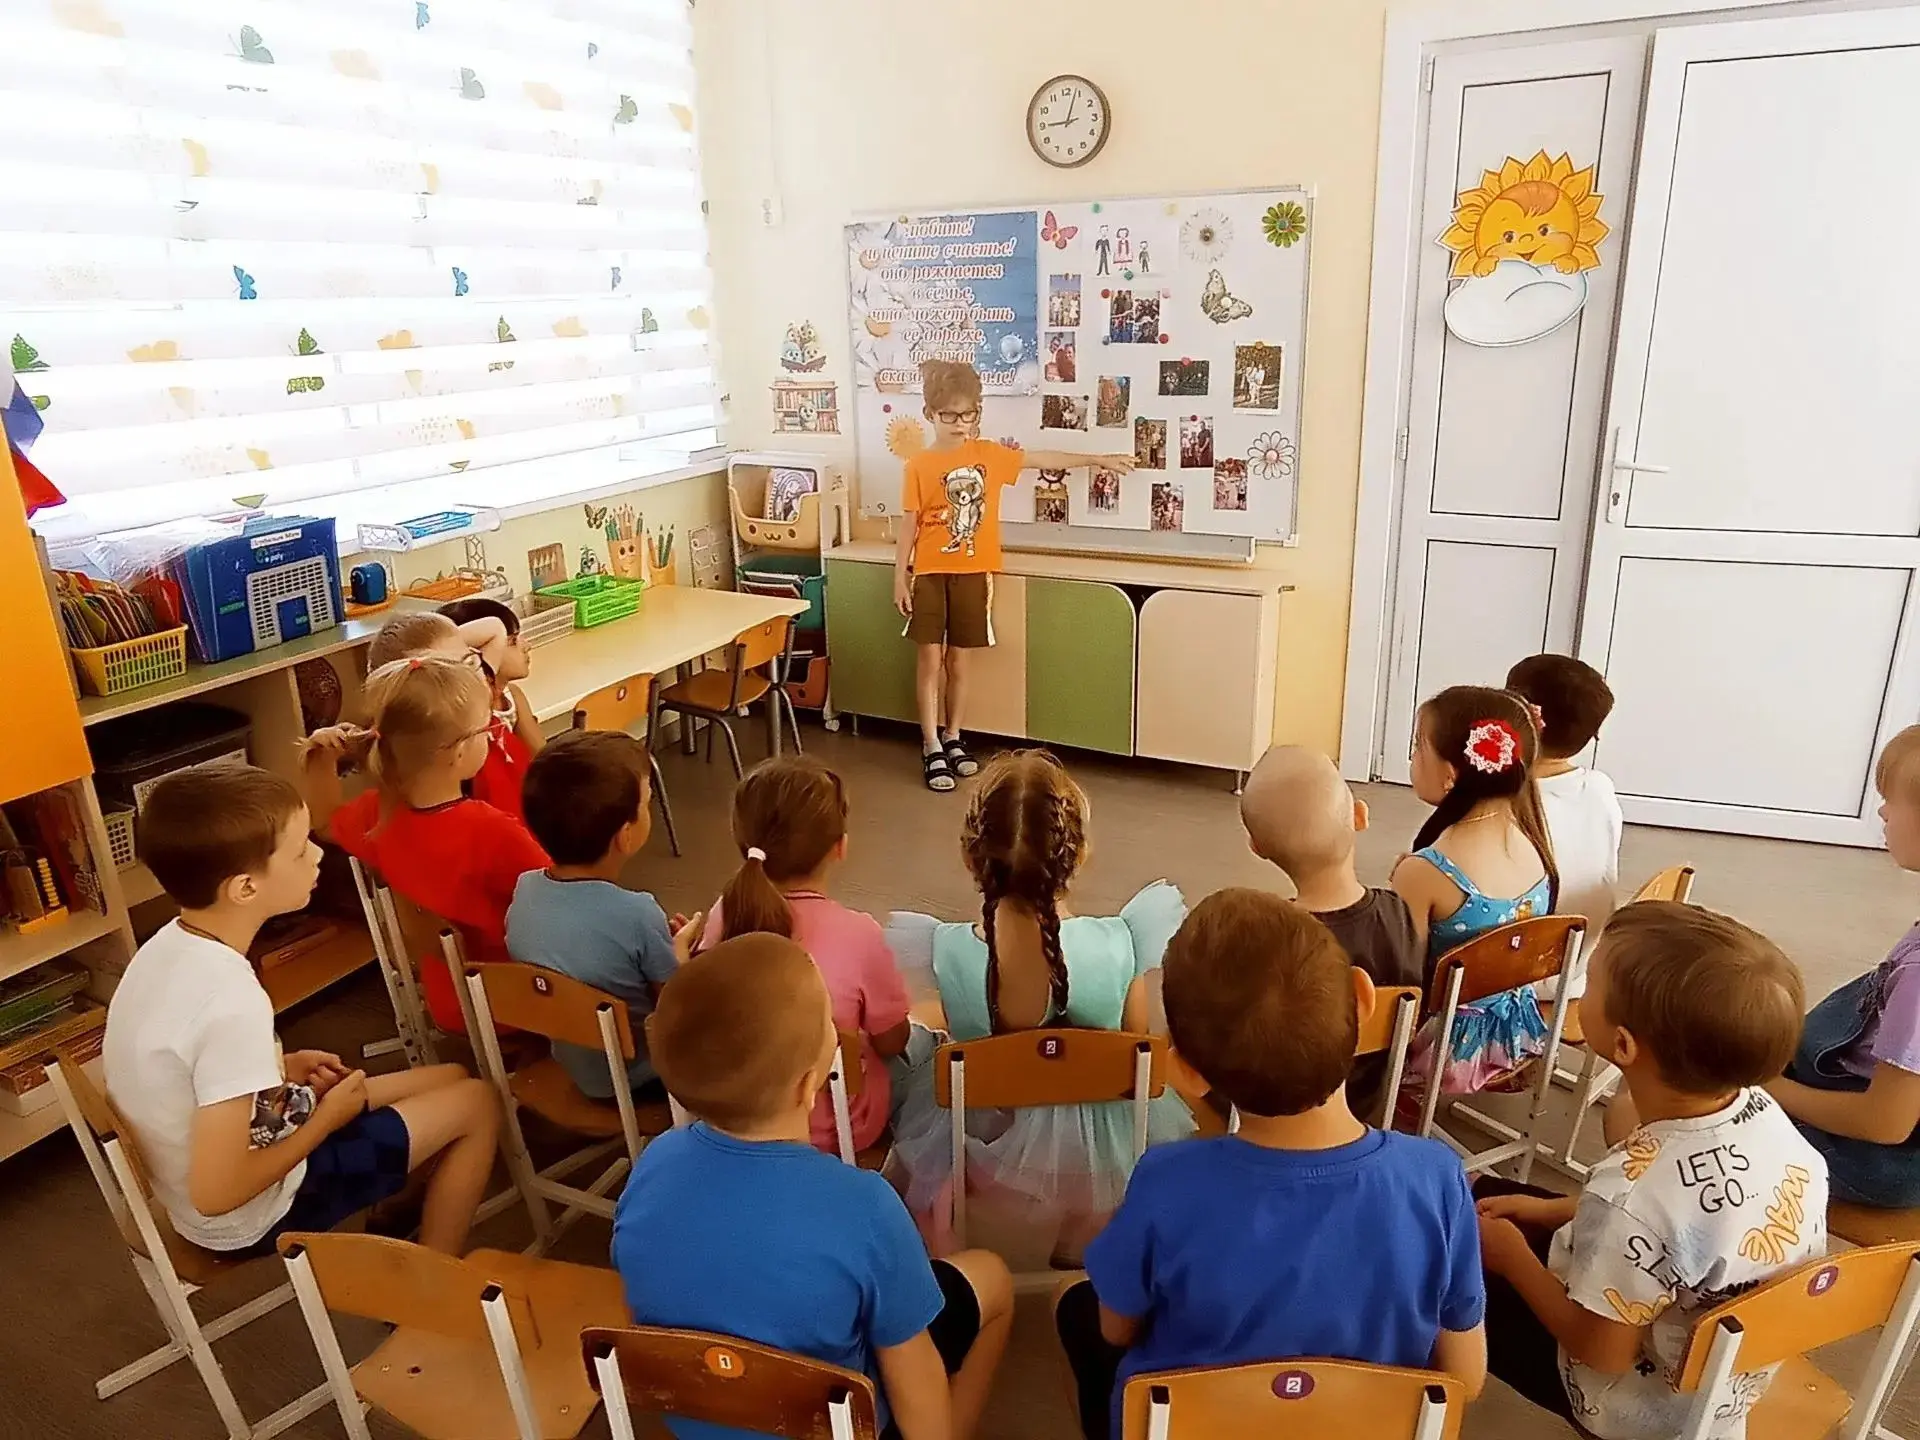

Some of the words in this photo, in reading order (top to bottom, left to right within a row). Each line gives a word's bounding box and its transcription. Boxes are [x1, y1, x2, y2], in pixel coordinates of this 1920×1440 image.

[1062, 88, 1071, 96] 12
[1050, 94, 1057, 102] 11
[1040, 106, 1048, 115] 10
[1091, 113, 1098, 121] 3
[1039, 122, 1046, 130] 9
[1068, 147, 1073, 156] 6
[943, 237, 1017, 258] счастье!
[881, 267, 908, 281] оно
[911, 260, 1004, 283] рождается
[871, 308, 903, 322] что
[969, 303, 1015, 323] быть
[1047, 1042, 1055, 1053] 2
[1676, 1143, 1750, 1187] LET'S
[1623, 1235, 1689, 1291] ET'S
[1287, 1379, 1299, 1391] 2
